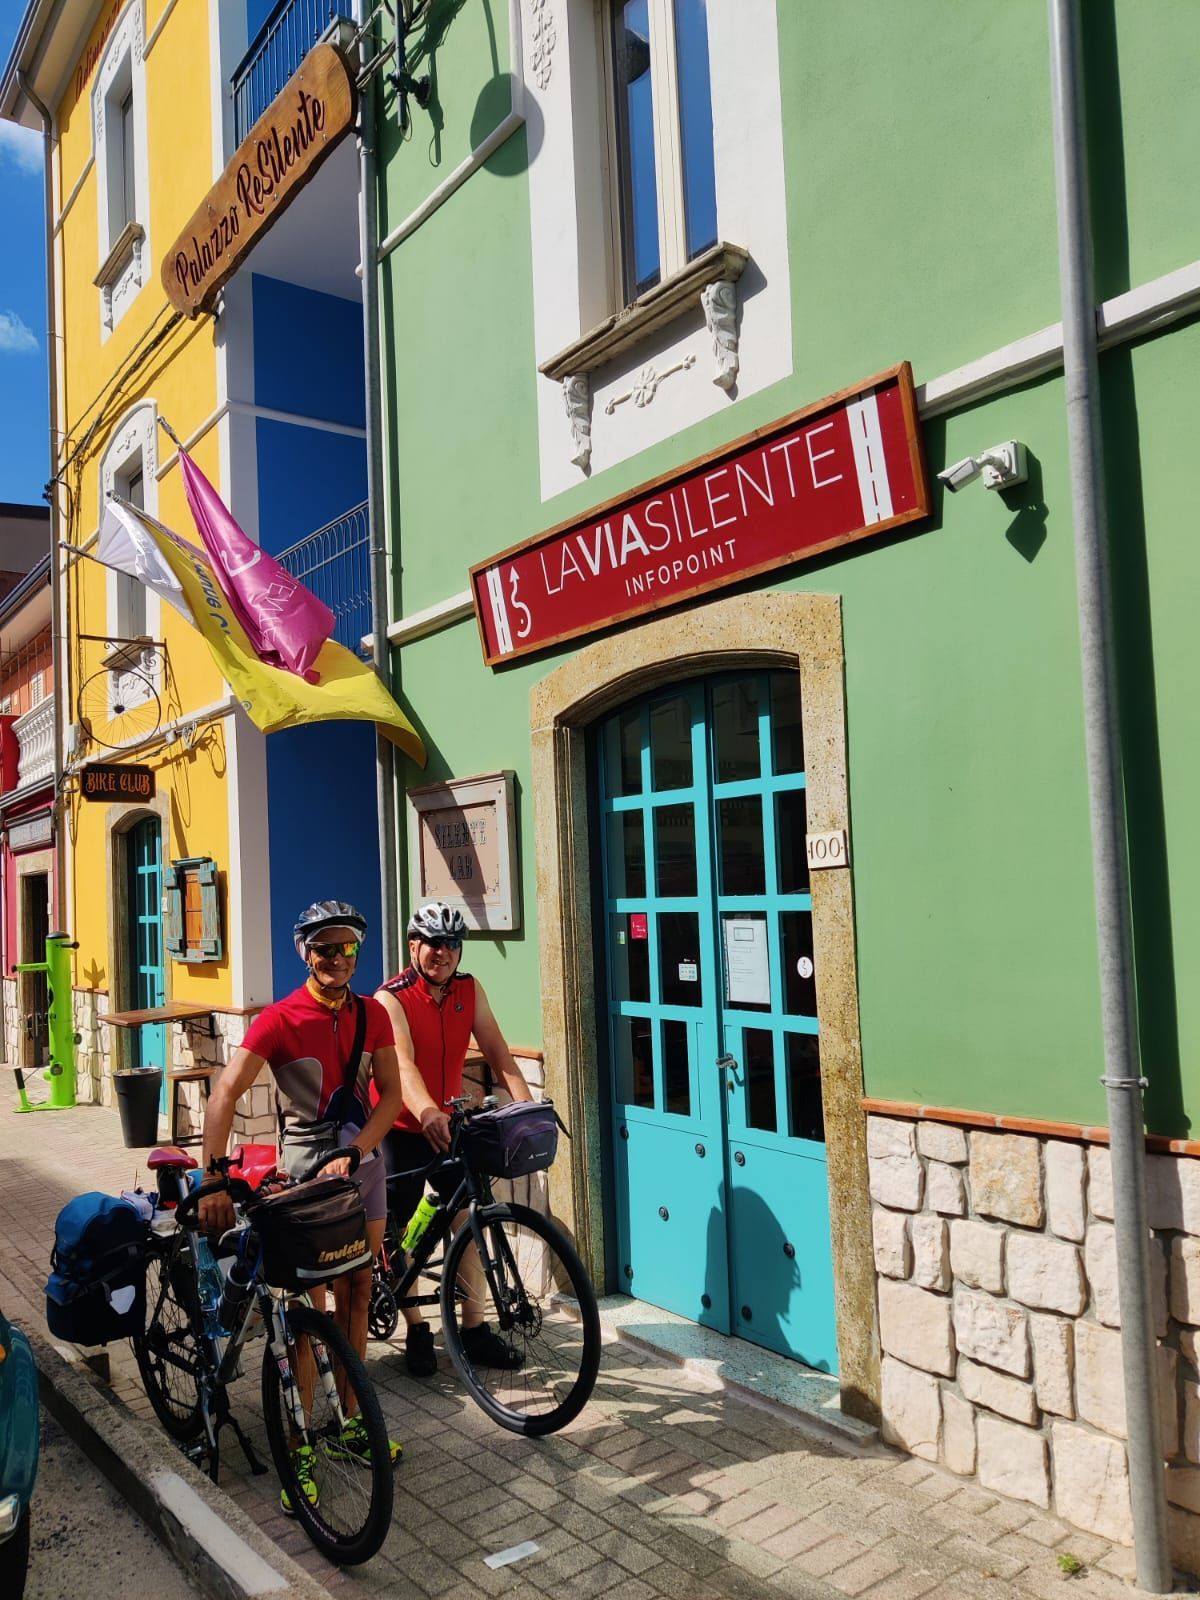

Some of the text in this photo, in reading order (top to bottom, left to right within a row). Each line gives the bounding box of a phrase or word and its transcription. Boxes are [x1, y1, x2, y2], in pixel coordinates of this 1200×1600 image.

[175, 90, 325, 296] Palazzo ReSilente
[625, 539, 736, 597] INFOPOINT
[85, 772, 150, 795] BIKE CLUB
[809, 837, 841, 860] 100
